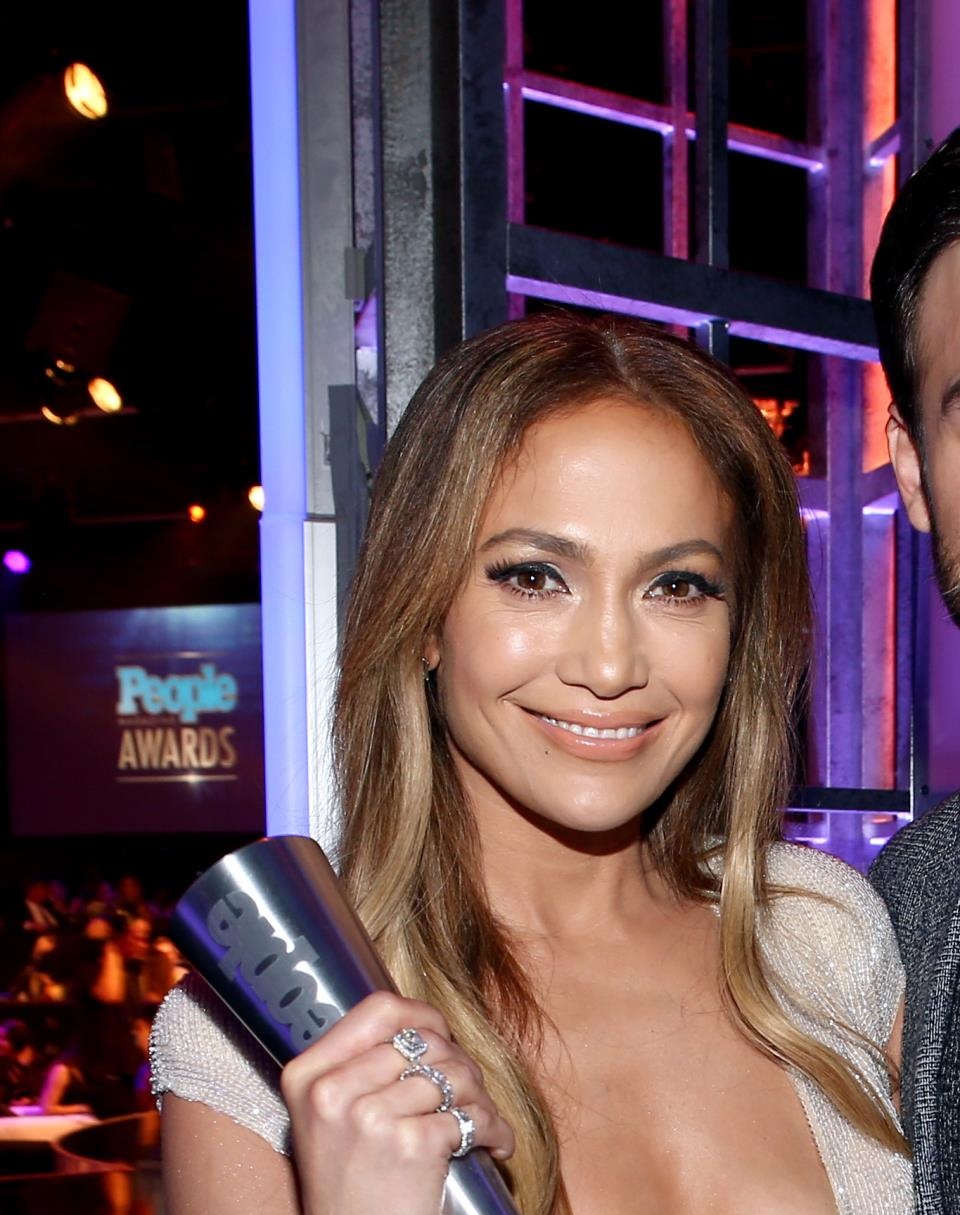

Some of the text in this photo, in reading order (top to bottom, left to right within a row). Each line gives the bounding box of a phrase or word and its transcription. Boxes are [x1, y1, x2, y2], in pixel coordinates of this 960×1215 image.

[114, 663, 238, 724] People
[117, 726, 237, 770] AWARDS
[207, 890, 346, 1056] eople
